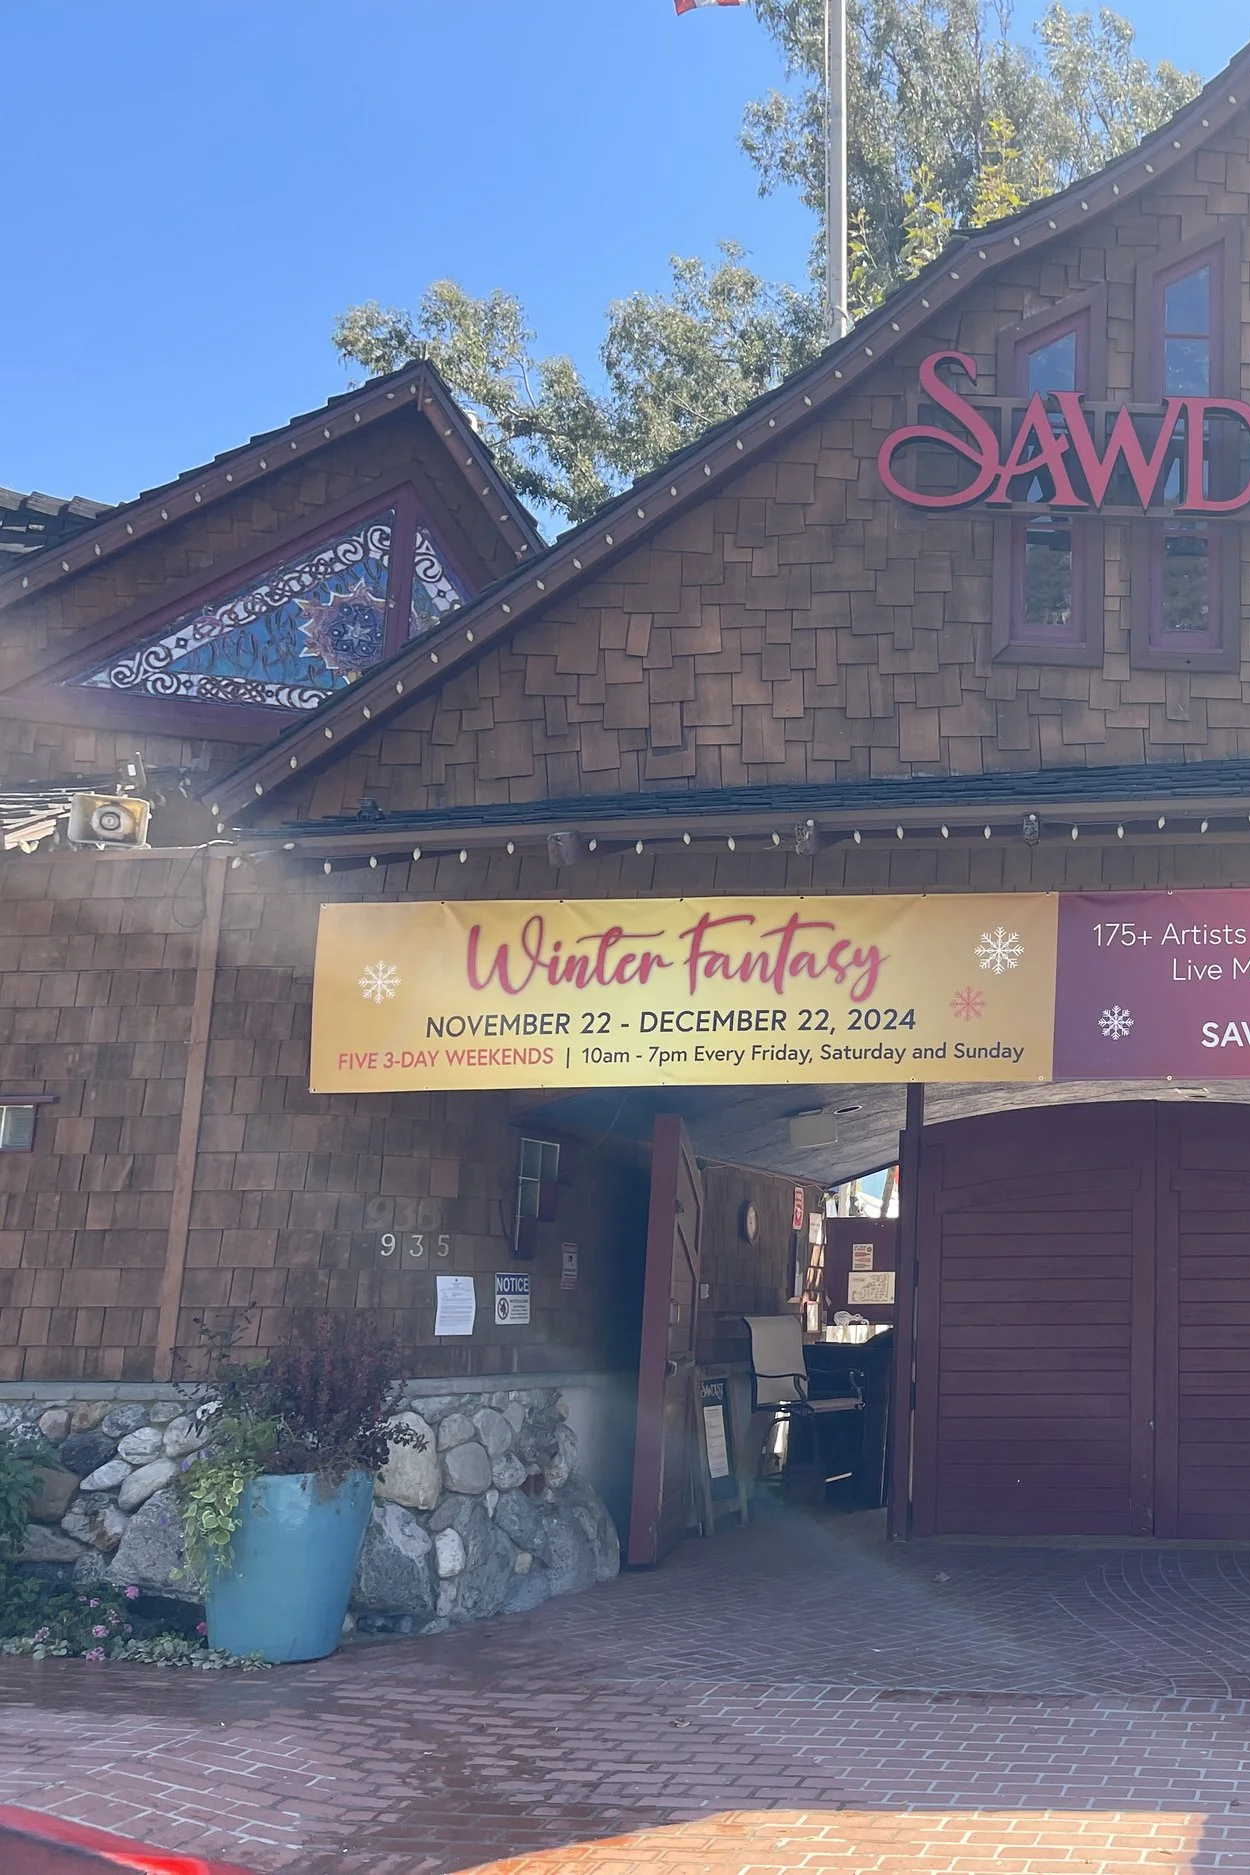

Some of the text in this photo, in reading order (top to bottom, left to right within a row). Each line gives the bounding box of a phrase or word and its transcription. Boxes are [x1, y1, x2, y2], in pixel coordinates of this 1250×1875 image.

[1093, 922, 1153, 947] 175+
[1161, 922, 1248, 946] Artists
[467, 911, 891, 1003] Winter Fantasy
[1172, 957, 1223, 981] Live
[426, 1012, 571, 1039] NOVEMBER
[579, 1011, 612, 1035] 22
[640, 1009, 788, 1034] DECEMBER
[797, 1008, 836, 1036] 22,
[847, 1007, 917, 1031] 2024
[338, 1053, 378, 1071] FIVE
[383, 1050, 440, 1070] 3-DAY
[445, 1047, 555, 1067] WEEKENDS
[581, 1046, 631, 1064] 10am
[648, 1046, 688, 1067] 7pm
[694, 1045, 746, 1066] Every
[751, 1043, 813, 1065] Friday,
[820, 1042, 906, 1065] Saturday
[912, 1041, 948, 1060] and
[953, 1041, 1025, 1063] Sunday
[380, 1233, 450, 1257] 935
[497, 1277, 530, 1292] NOTICE
